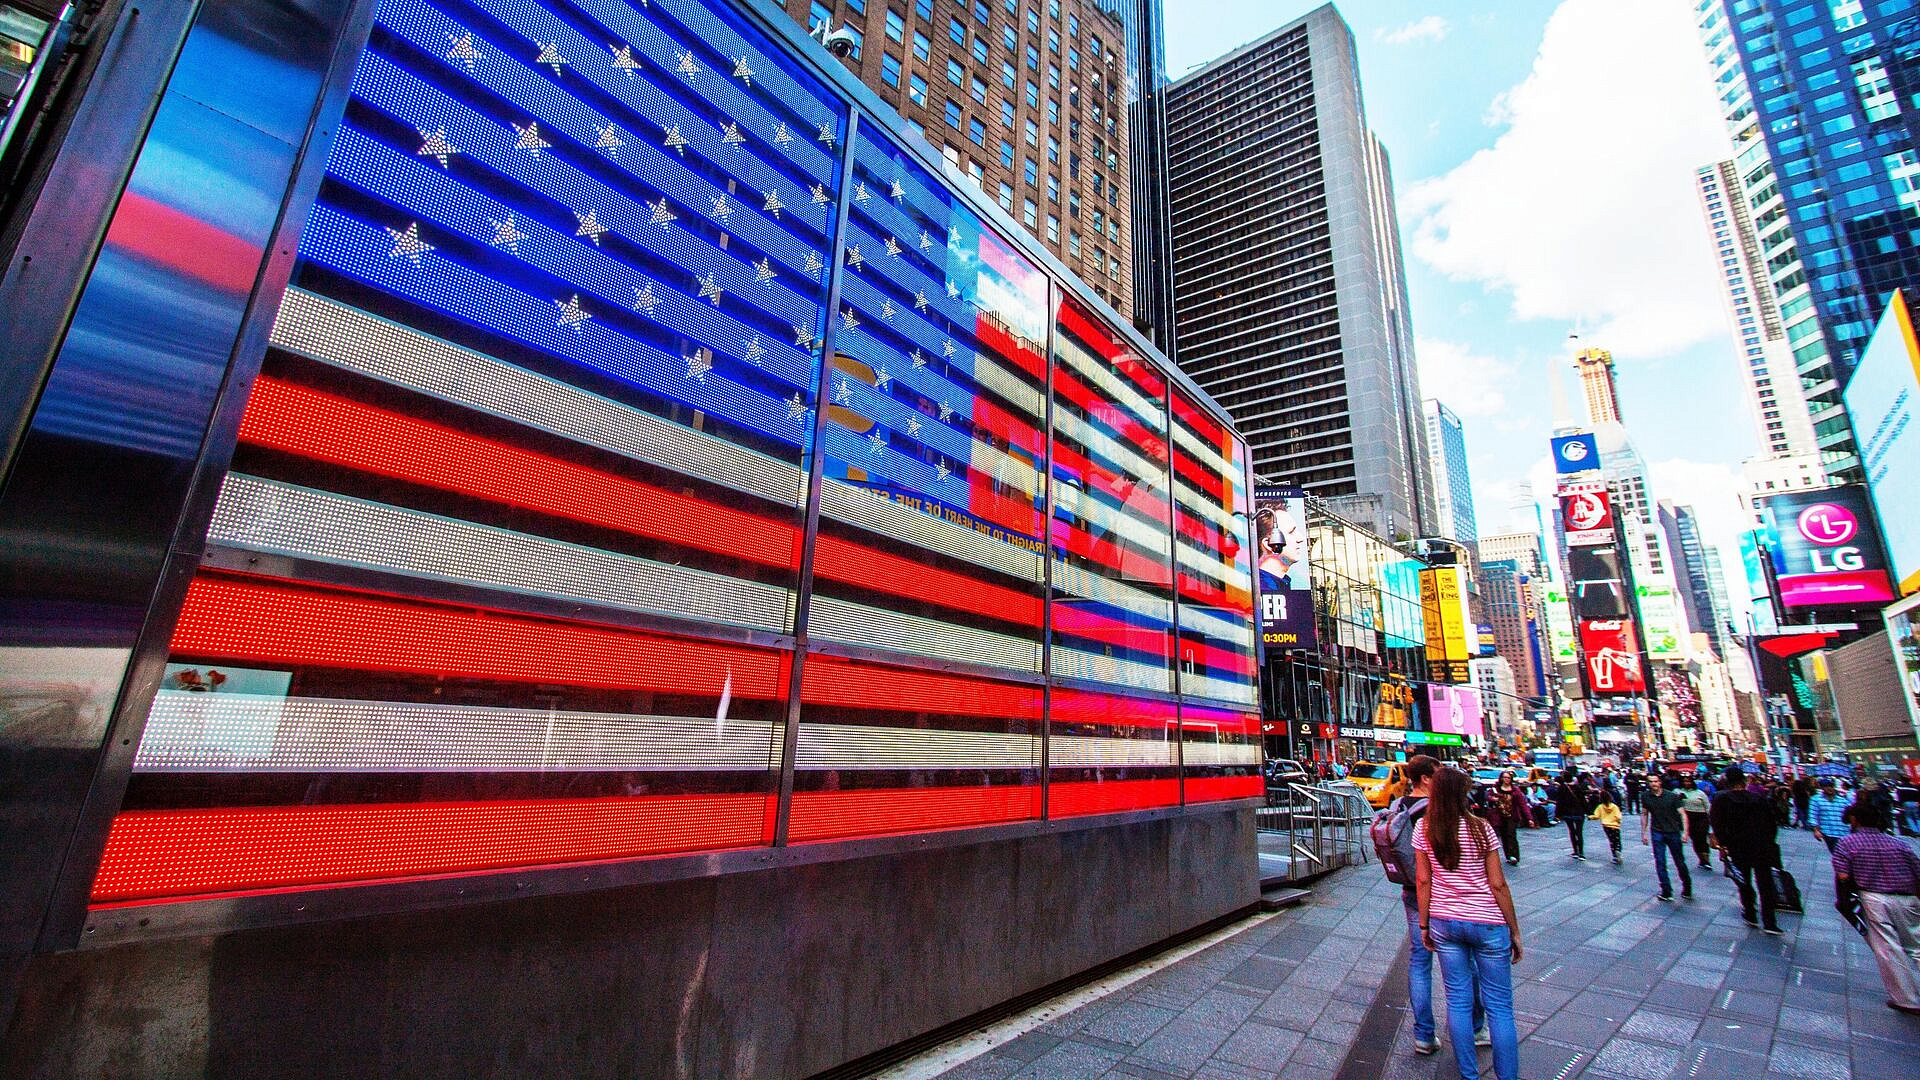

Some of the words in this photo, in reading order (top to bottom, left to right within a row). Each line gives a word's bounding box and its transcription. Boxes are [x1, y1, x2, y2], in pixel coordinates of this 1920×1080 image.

[1808, 546, 1865, 573] LG
[1261, 594, 1287, 620] ER
[1263, 633, 1297, 643] 0:30PM
